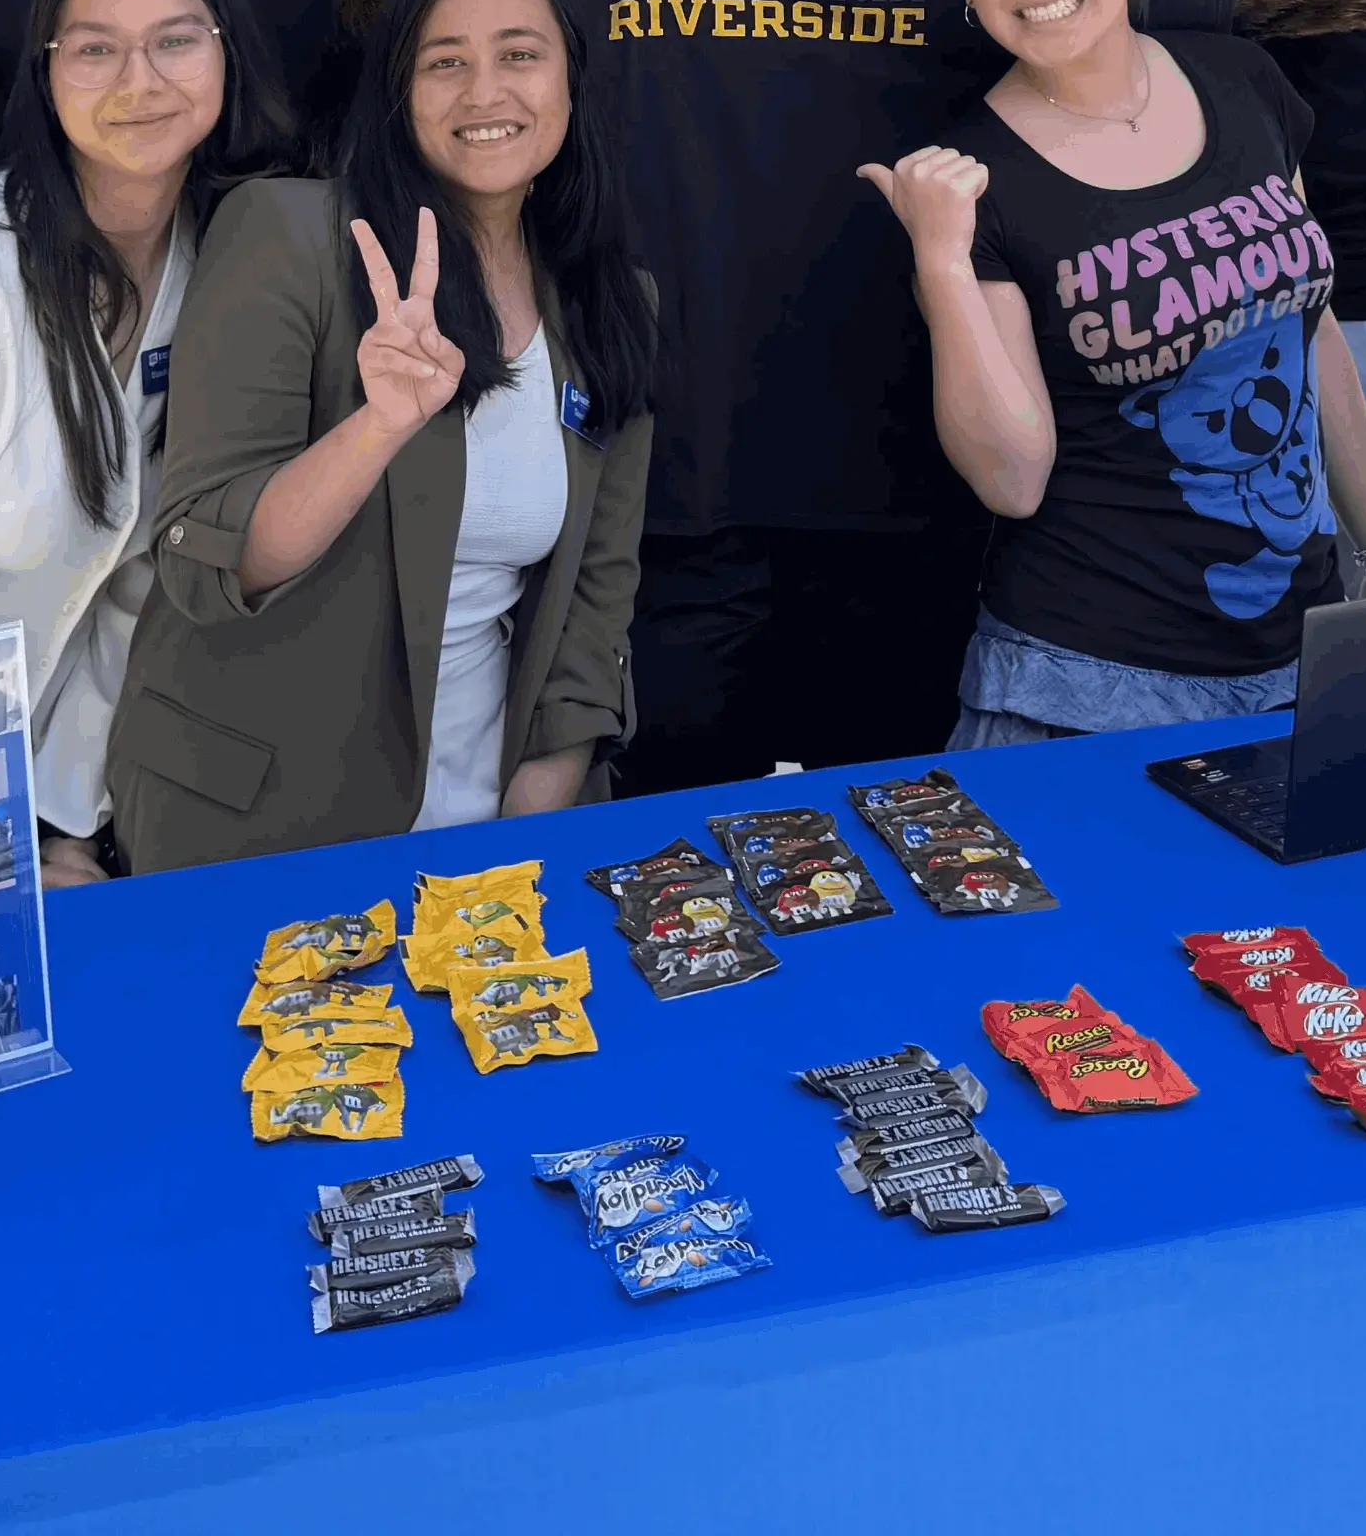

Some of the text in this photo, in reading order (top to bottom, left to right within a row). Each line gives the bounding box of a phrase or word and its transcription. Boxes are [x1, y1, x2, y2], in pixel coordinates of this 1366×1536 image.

[1056, 174, 1305, 309] HYSTERIC
[1068, 220, 1334, 360] GLAMOUR
[1088, 333, 1195, 386] WHAT
[1203, 306, 1246, 350] DO
[1252, 297, 1264, 328] I
[1046, 1024, 1112, 1054] Reese's
[847, 1070, 932, 1095] HERSHEY'S
[1071, 1058, 1150, 1080] Reese's
[856, 1092, 943, 1118] HERSHEY'S
[878, 1114, 967, 1143] HERSHEY'S
[371, 1160, 461, 1192] HERSHEY'S
[320, 1196, 412, 1224] HERSHEY'S
[924, 1186, 1019, 1213] HERSHEY'S
[331, 1248, 426, 1275] HERSHEY'S
